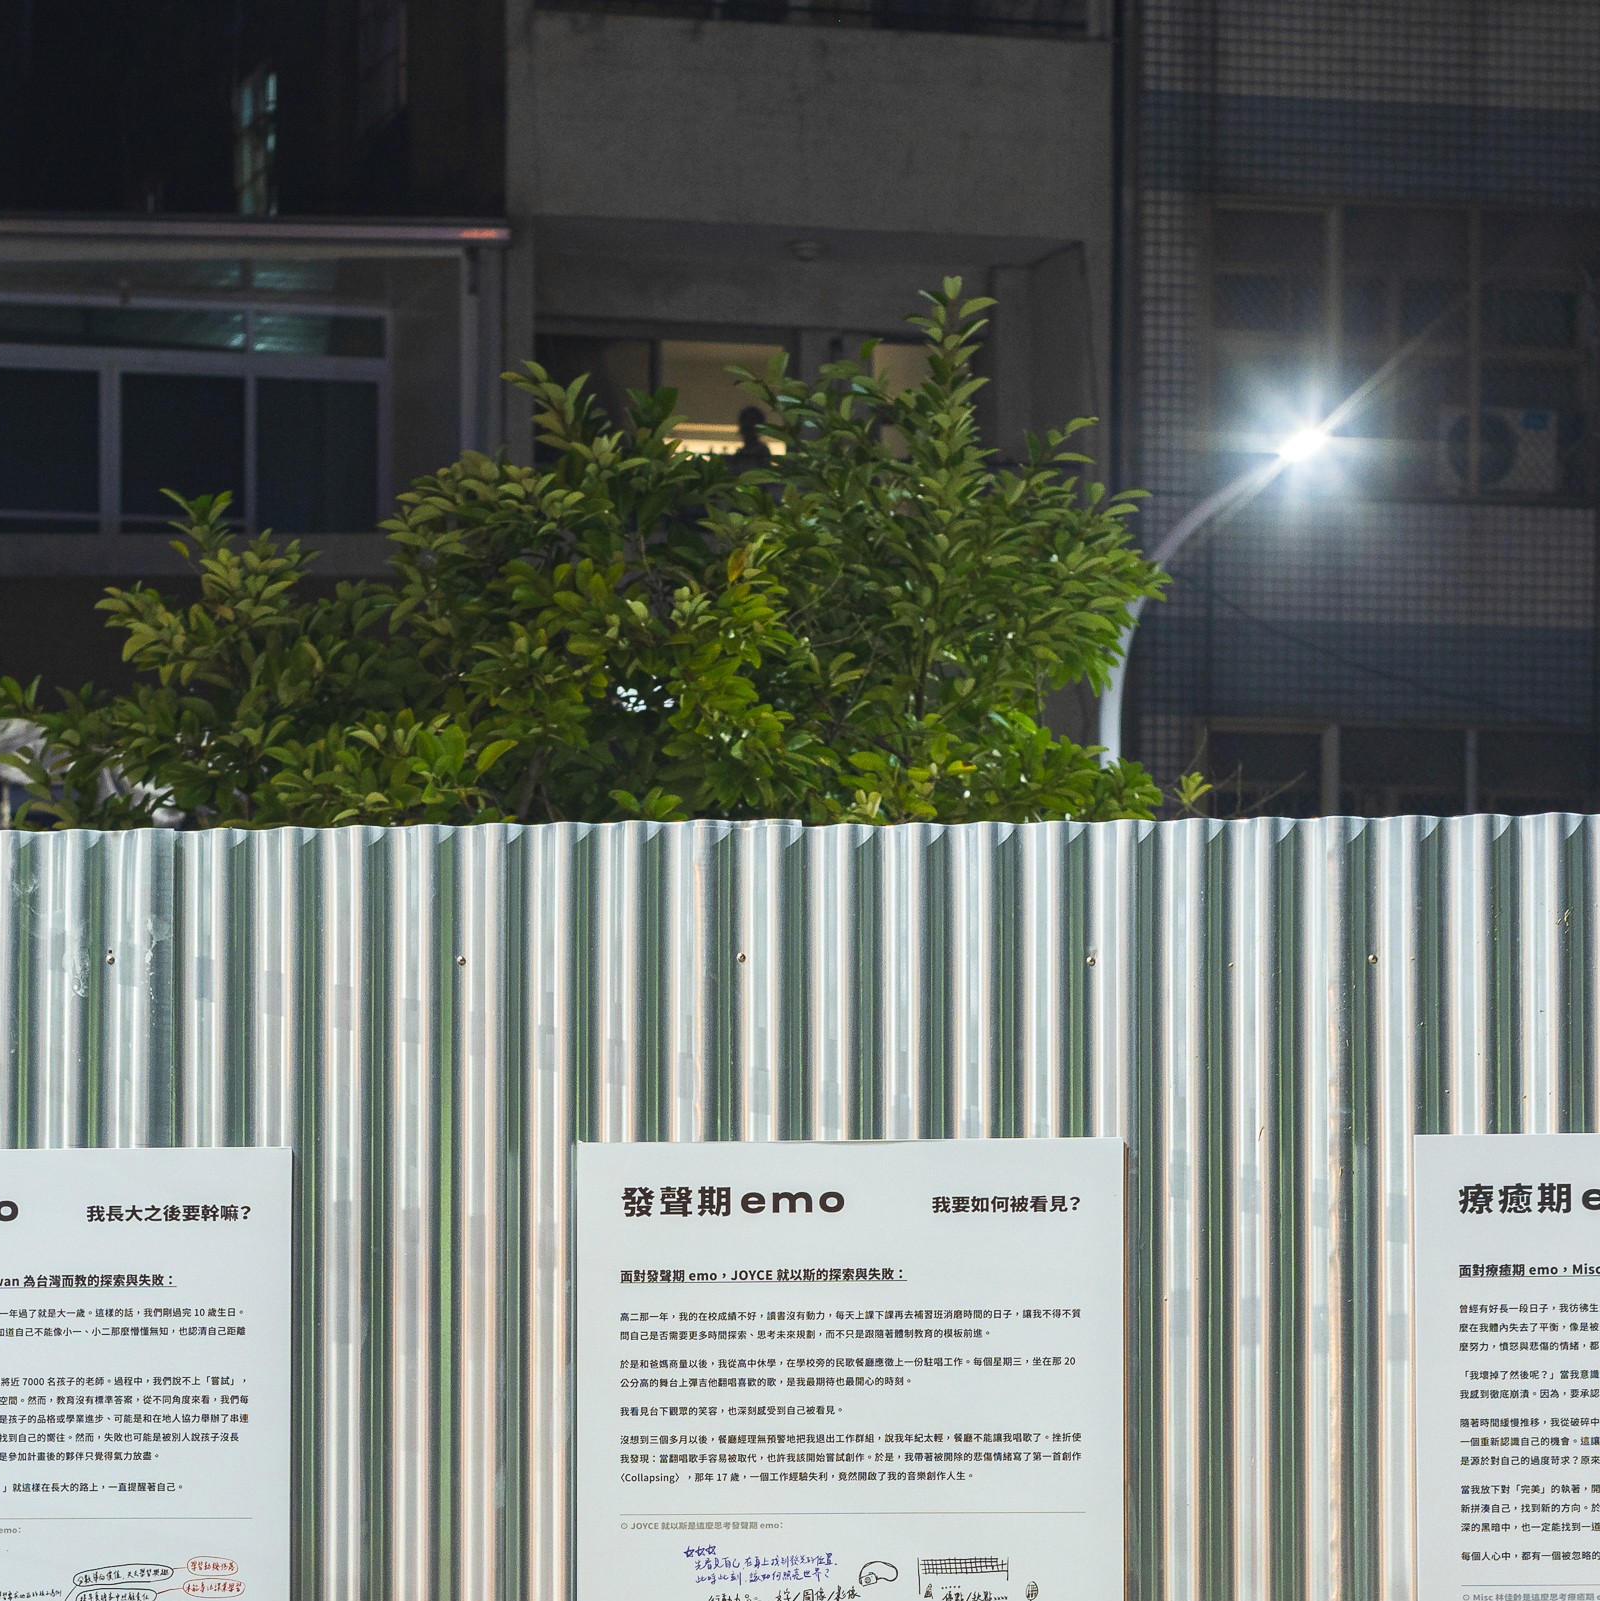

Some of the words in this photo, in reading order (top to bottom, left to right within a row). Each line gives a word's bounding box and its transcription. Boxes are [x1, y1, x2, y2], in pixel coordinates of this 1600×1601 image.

[931, 1195, 1081, 1214] 我要如何被看見？
[86, 1204, 252, 1223] 我長大之後要幹嘛？
[620, 1268, 685, 1282] 面對發聲期
[776, 1268, 905, 1282] 就以斯的探索與失敗：
[1459, 1262, 1524, 1276] 面對療癒期
[23, 1276, 175, 1289] 為台灣而教的探索與失敗：
[22, 1377, 45, 1387] 7000
[619, 1405, 843, 1417] 我看見台下觀眾的笑容，也深刻感受到自己被看見。
